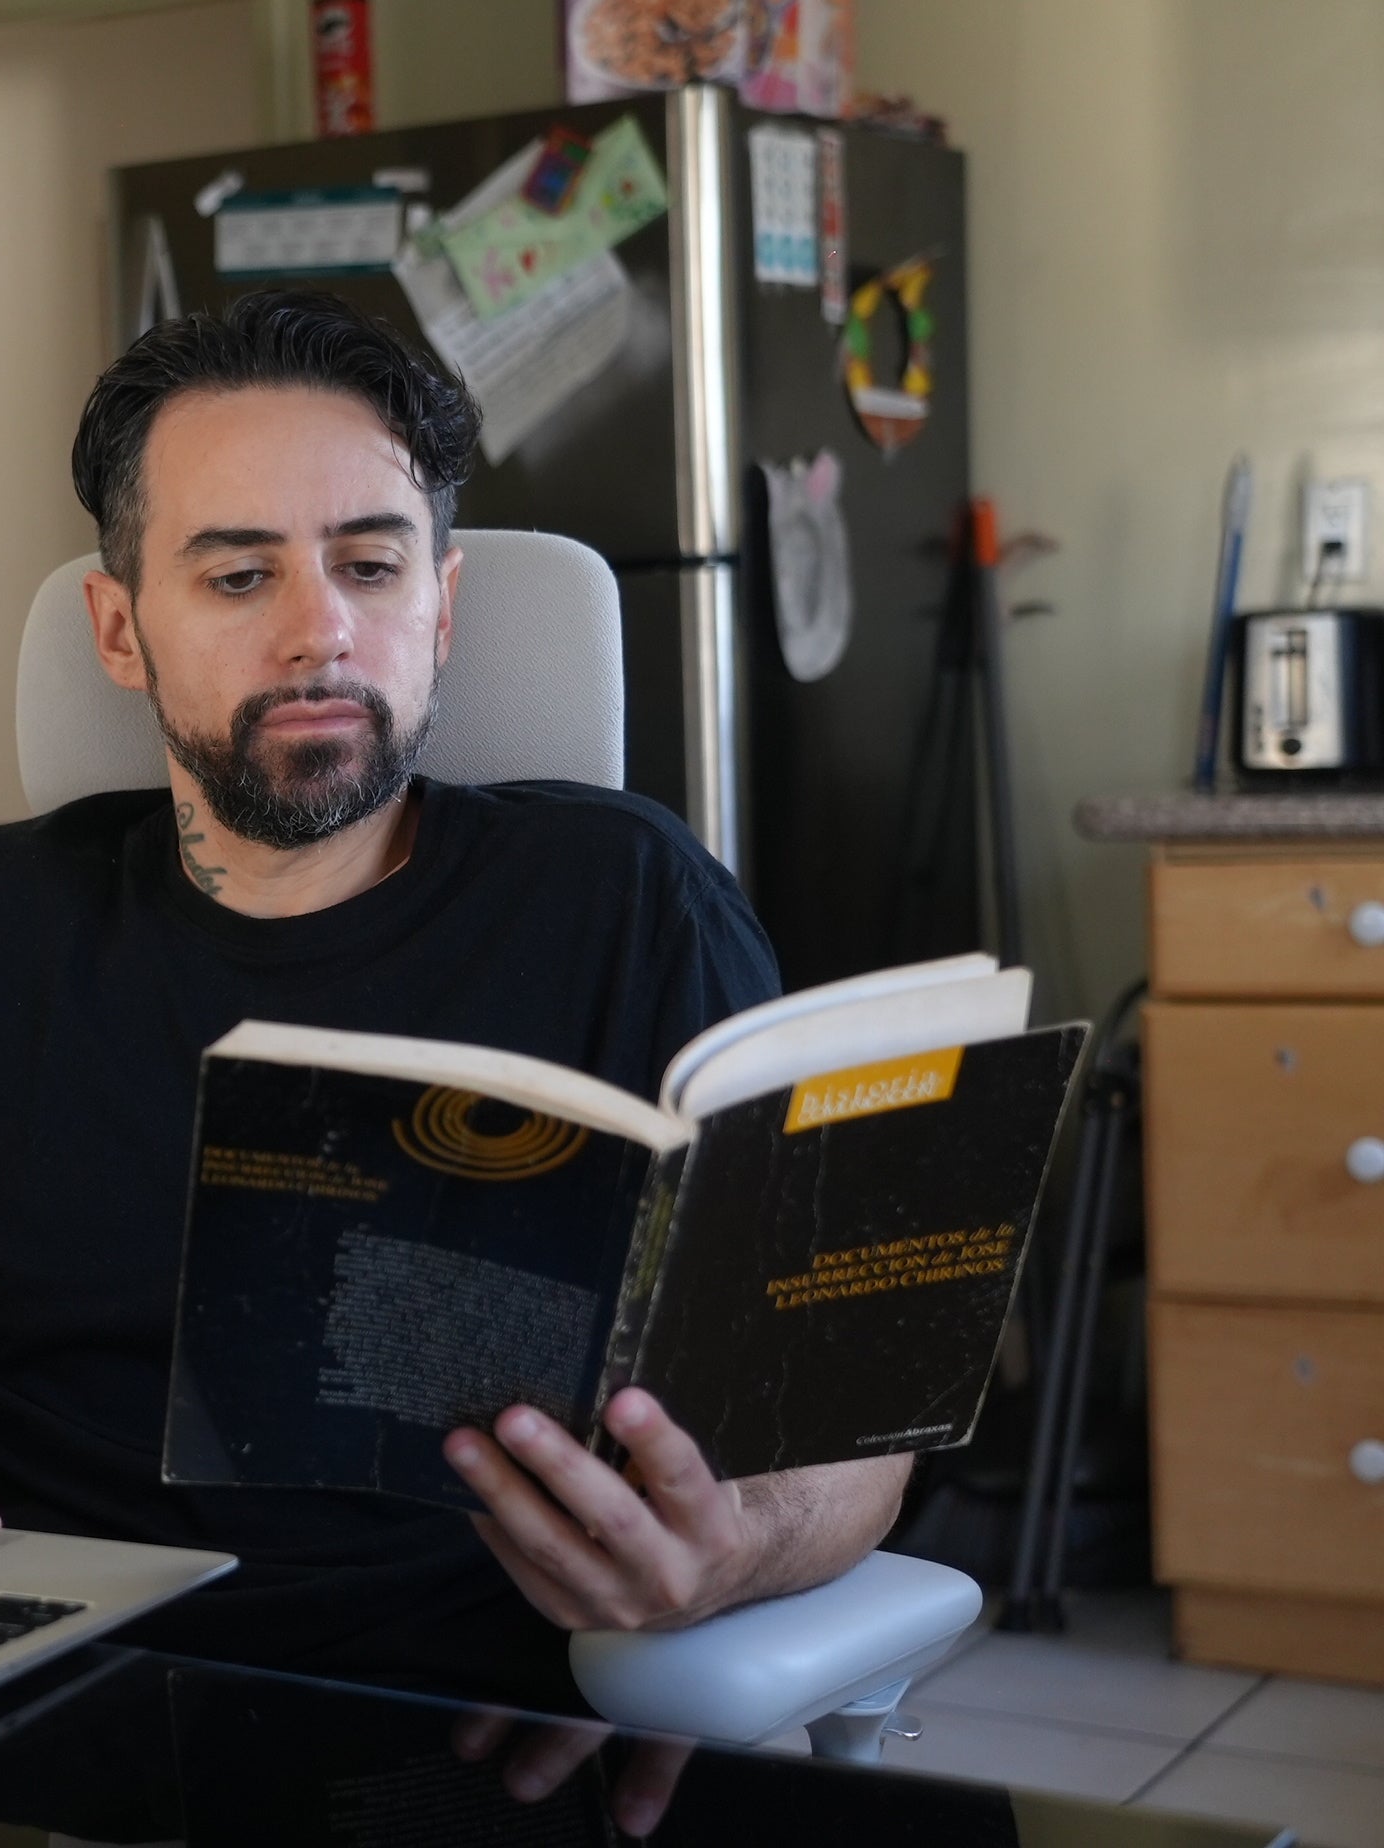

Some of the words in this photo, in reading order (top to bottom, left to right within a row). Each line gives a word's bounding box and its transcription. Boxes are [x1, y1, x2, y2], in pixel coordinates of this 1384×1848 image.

[812, 1230, 967, 1270] DOCUMENTOS
[766, 1252, 929, 1297] INSURRECCION
[774, 1275, 898, 1311] LEONARDO
[899, 1257, 1006, 1288] CHIRINOS
